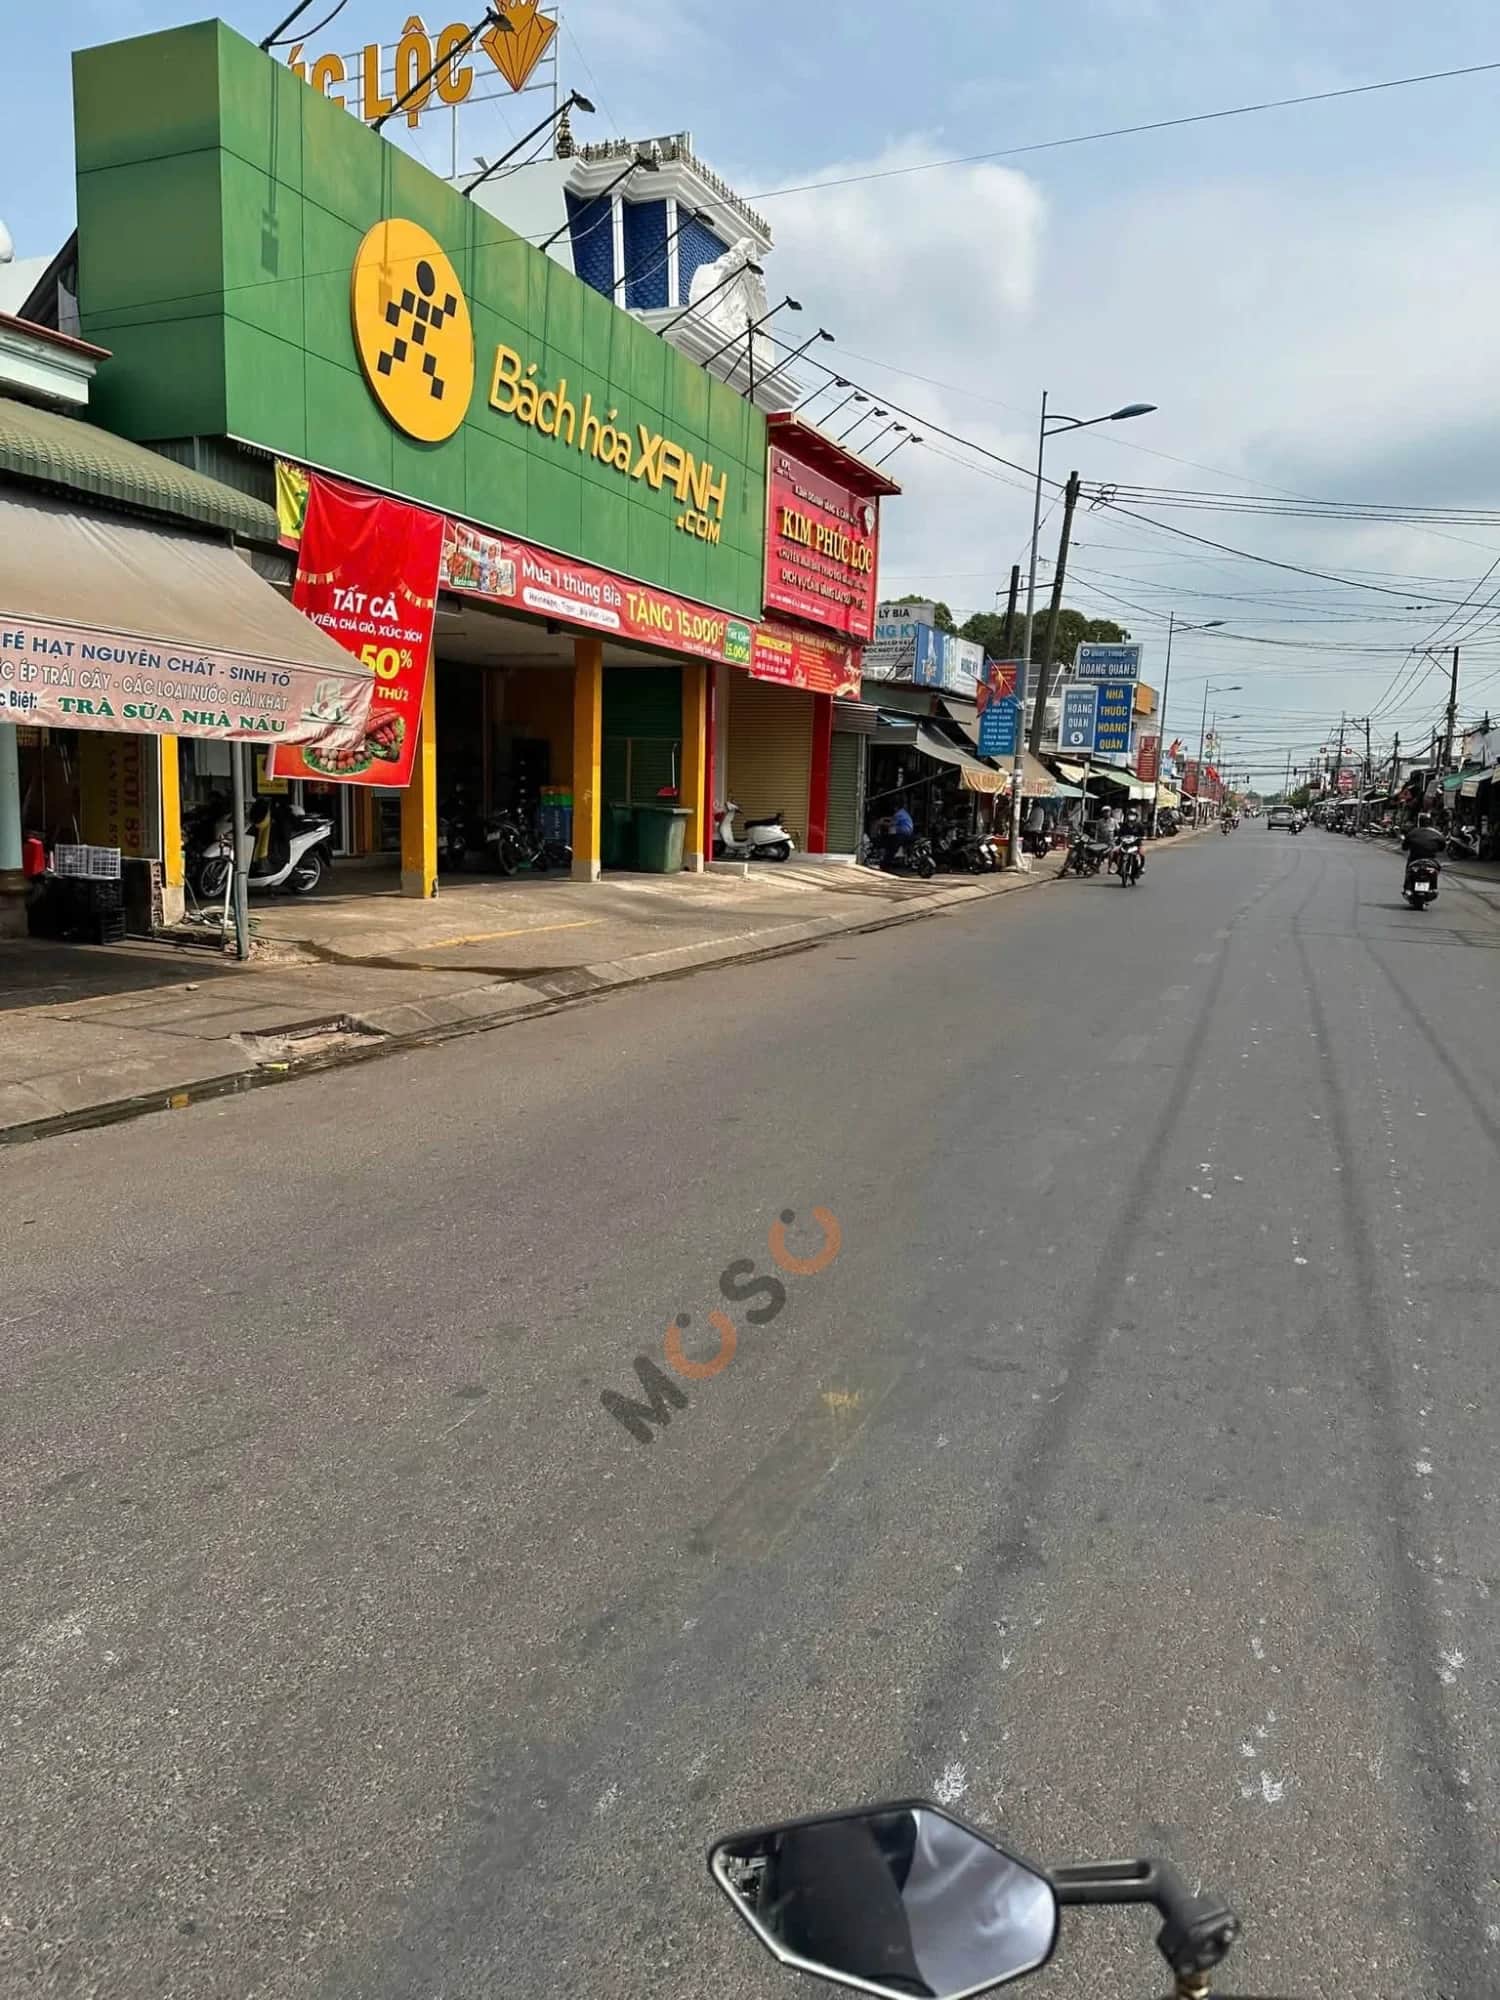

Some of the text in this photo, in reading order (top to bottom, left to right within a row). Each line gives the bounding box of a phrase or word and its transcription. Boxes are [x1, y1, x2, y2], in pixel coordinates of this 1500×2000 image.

[363, 16, 474, 128] LỘC
[490, 344, 728, 519] Bách hóa XANH
[782, 506, 873, 577] KIM PHÚC LỘC
[522, 558, 622, 606] Mua 1 thùng Bia
[781, 568, 797, 586] DỊCH
[333, 584, 399, 621] TẤT CẢ
[626, 589, 673, 632] TẶNG
[892, 607, 911, 617] BIA
[310, 611, 338, 630] VIÊN,
[340, 616, 357, 631] CHẢ
[359, 620, 376, 636] GIÒ,
[379, 624, 403, 640] XÚC
[33, 637, 75, 660] HẠT
[82, 643, 161, 669] NGUYÊN
[168, 656, 216, 677] CHẤT
[229, 667, 267, 684] SINH
[272, 669, 292, 687] TỐ
[360, 643, 413, 680] 50%
[10, 690, 38, 713] Biệt:
[20, 657, 38, 682] ÉP
[41, 663, 75, 686] TRÁI
[80, 667, 112, 690] CÂY
[122, 672, 154, 695] CÁC
[157, 680, 187, 702] LOẠI
[190, 684, 228, 705] NƯỚC
[230, 688, 256, 709] GIẢI
[259, 690, 289, 712] KHÁT
[376, 684, 402, 701] THỨ
[58, 696, 286, 733] TRÀ SỮA NHÀ NẤU
